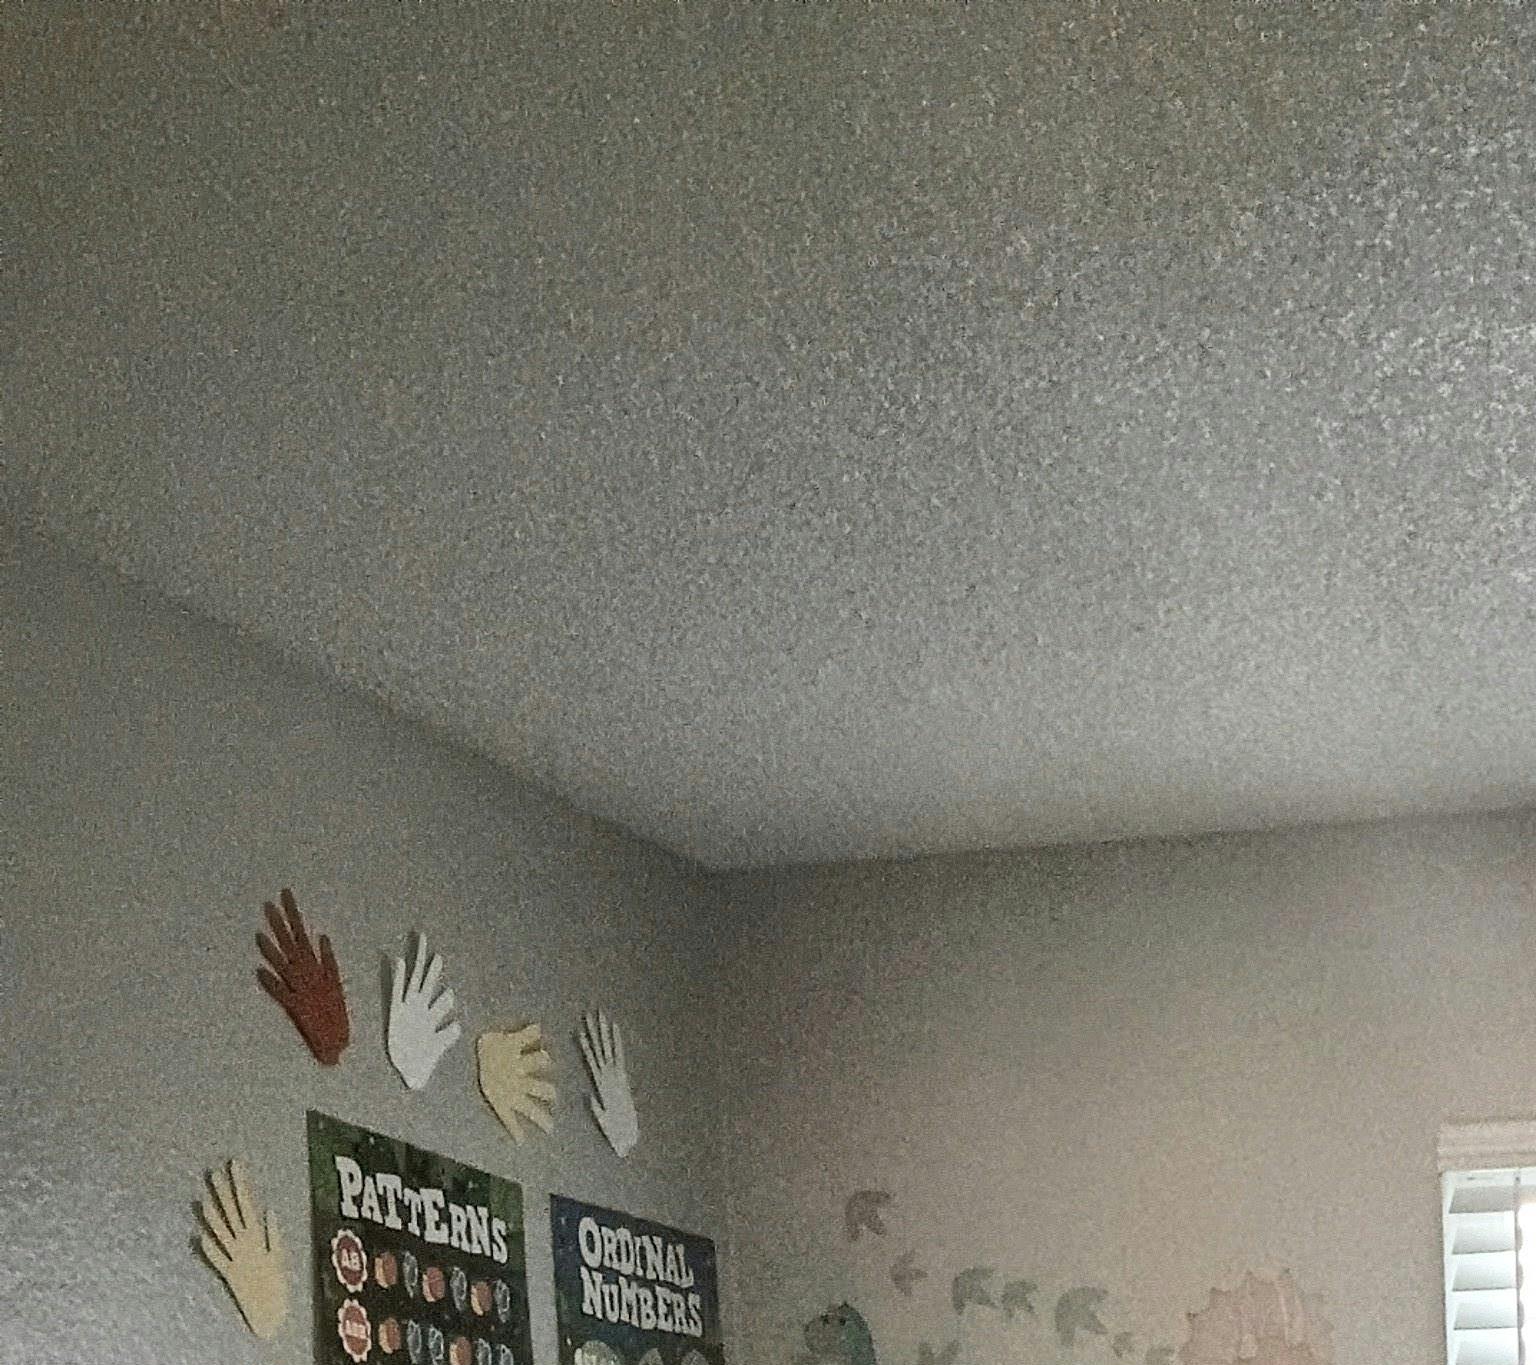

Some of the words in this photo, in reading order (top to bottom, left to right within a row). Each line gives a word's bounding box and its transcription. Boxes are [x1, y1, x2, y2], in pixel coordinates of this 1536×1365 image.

[335, 1156, 509, 1264] PATTERNS
[579, 1217, 694, 1288] ORDINAL
[580, 1266, 702, 1337] NUMBERS
